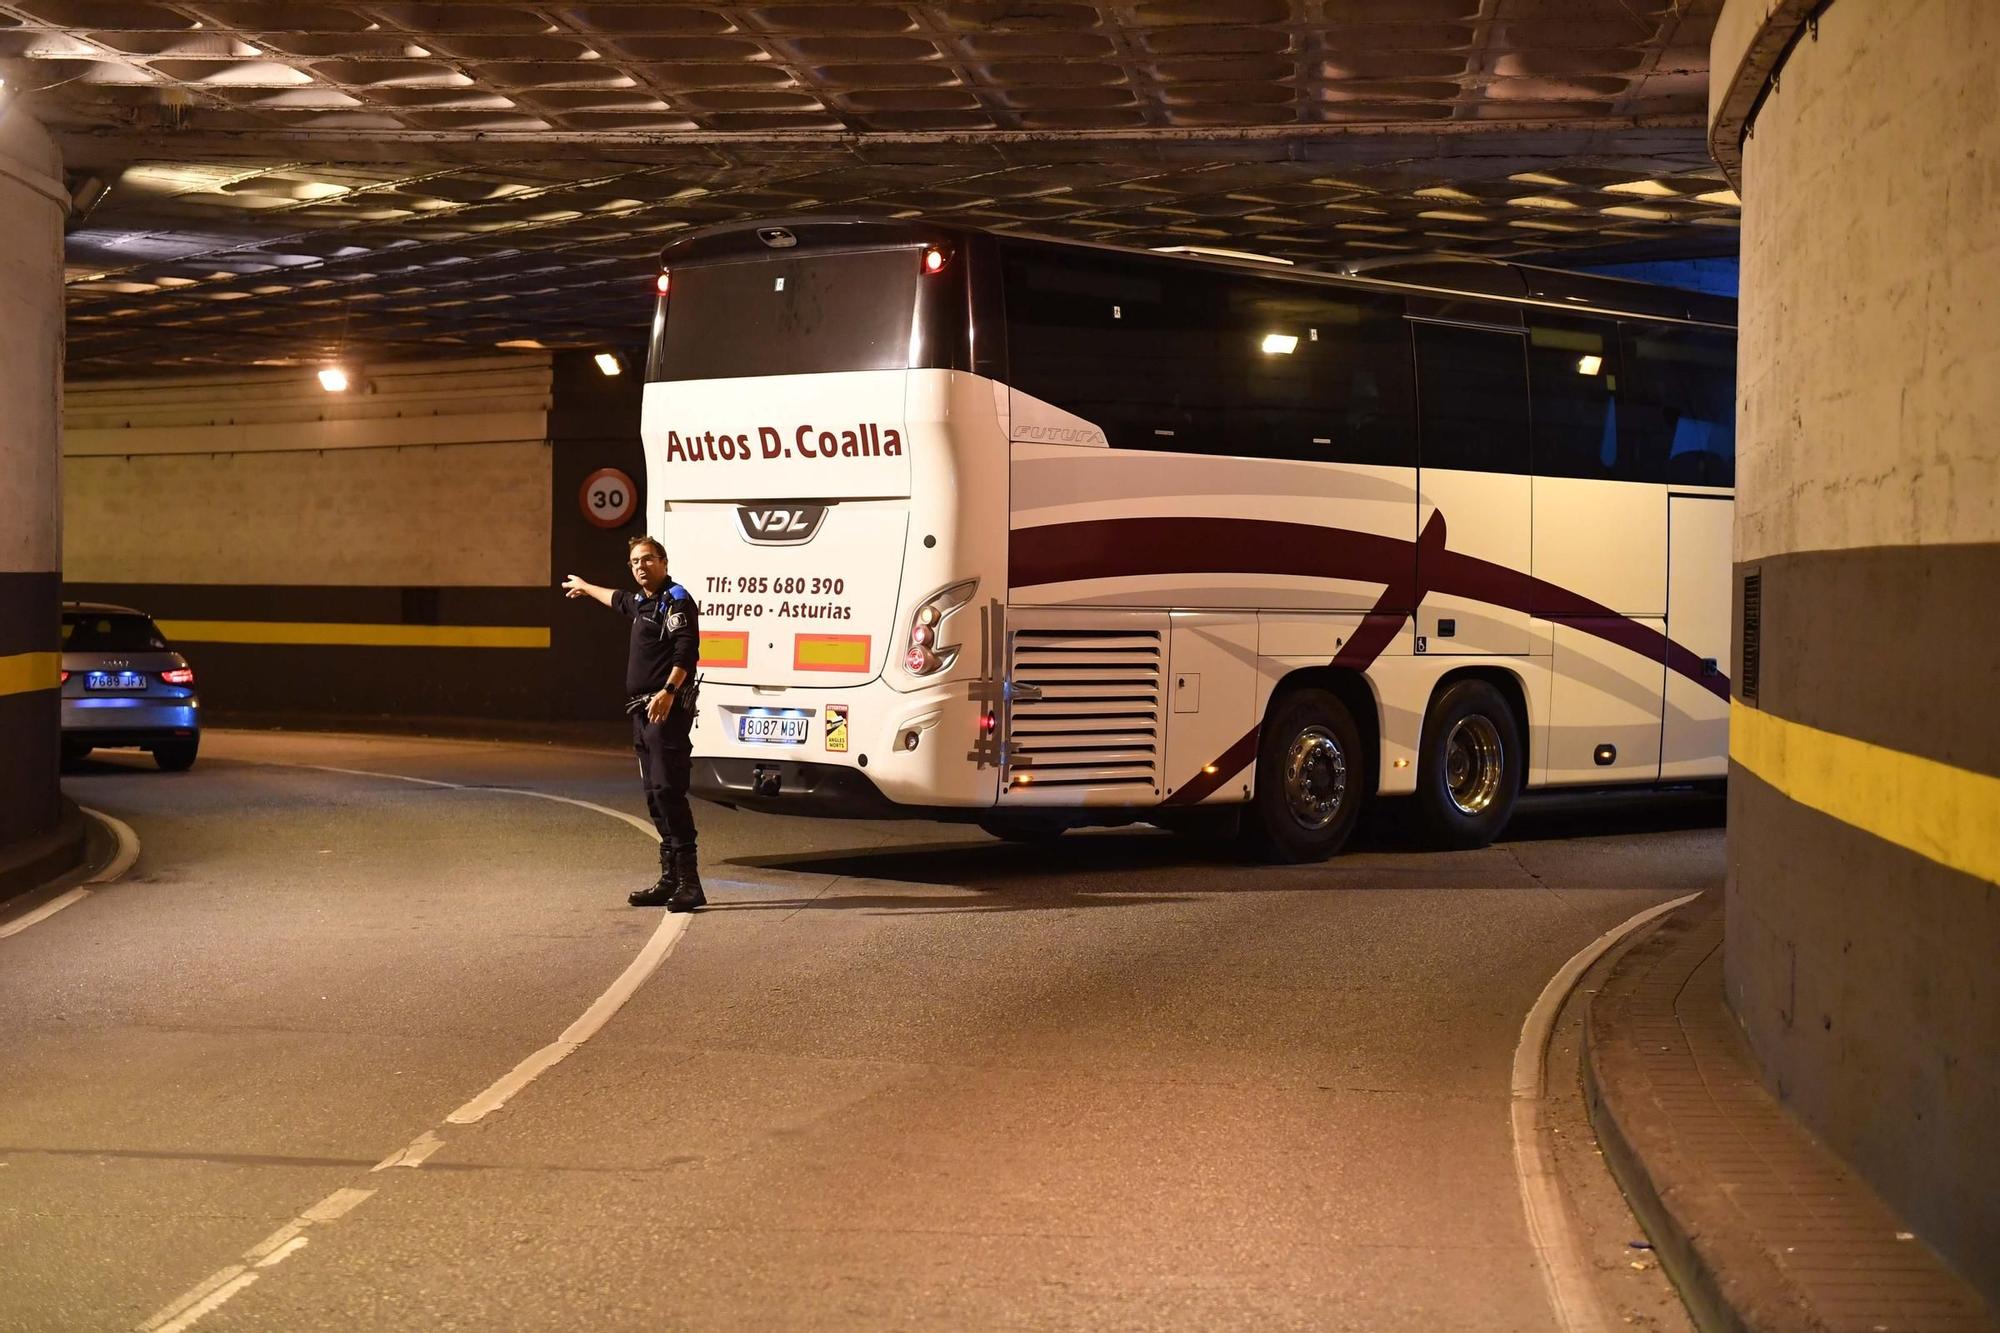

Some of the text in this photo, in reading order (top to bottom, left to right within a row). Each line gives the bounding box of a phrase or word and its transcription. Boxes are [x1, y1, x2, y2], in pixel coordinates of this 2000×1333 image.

[667, 423, 902, 462] Autos D. Coalla
[593, 490, 623, 508] 30
[748, 510, 809, 532] VDL
[706, 576, 844, 595] Tlf: 985 680 390
[698, 600, 764, 621] Langreo
[778, 601, 852, 620] Asturias
[91, 675, 120, 687] 7689
[747, 720, 777, 736] 8087
[781, 721, 804, 737] MBV
